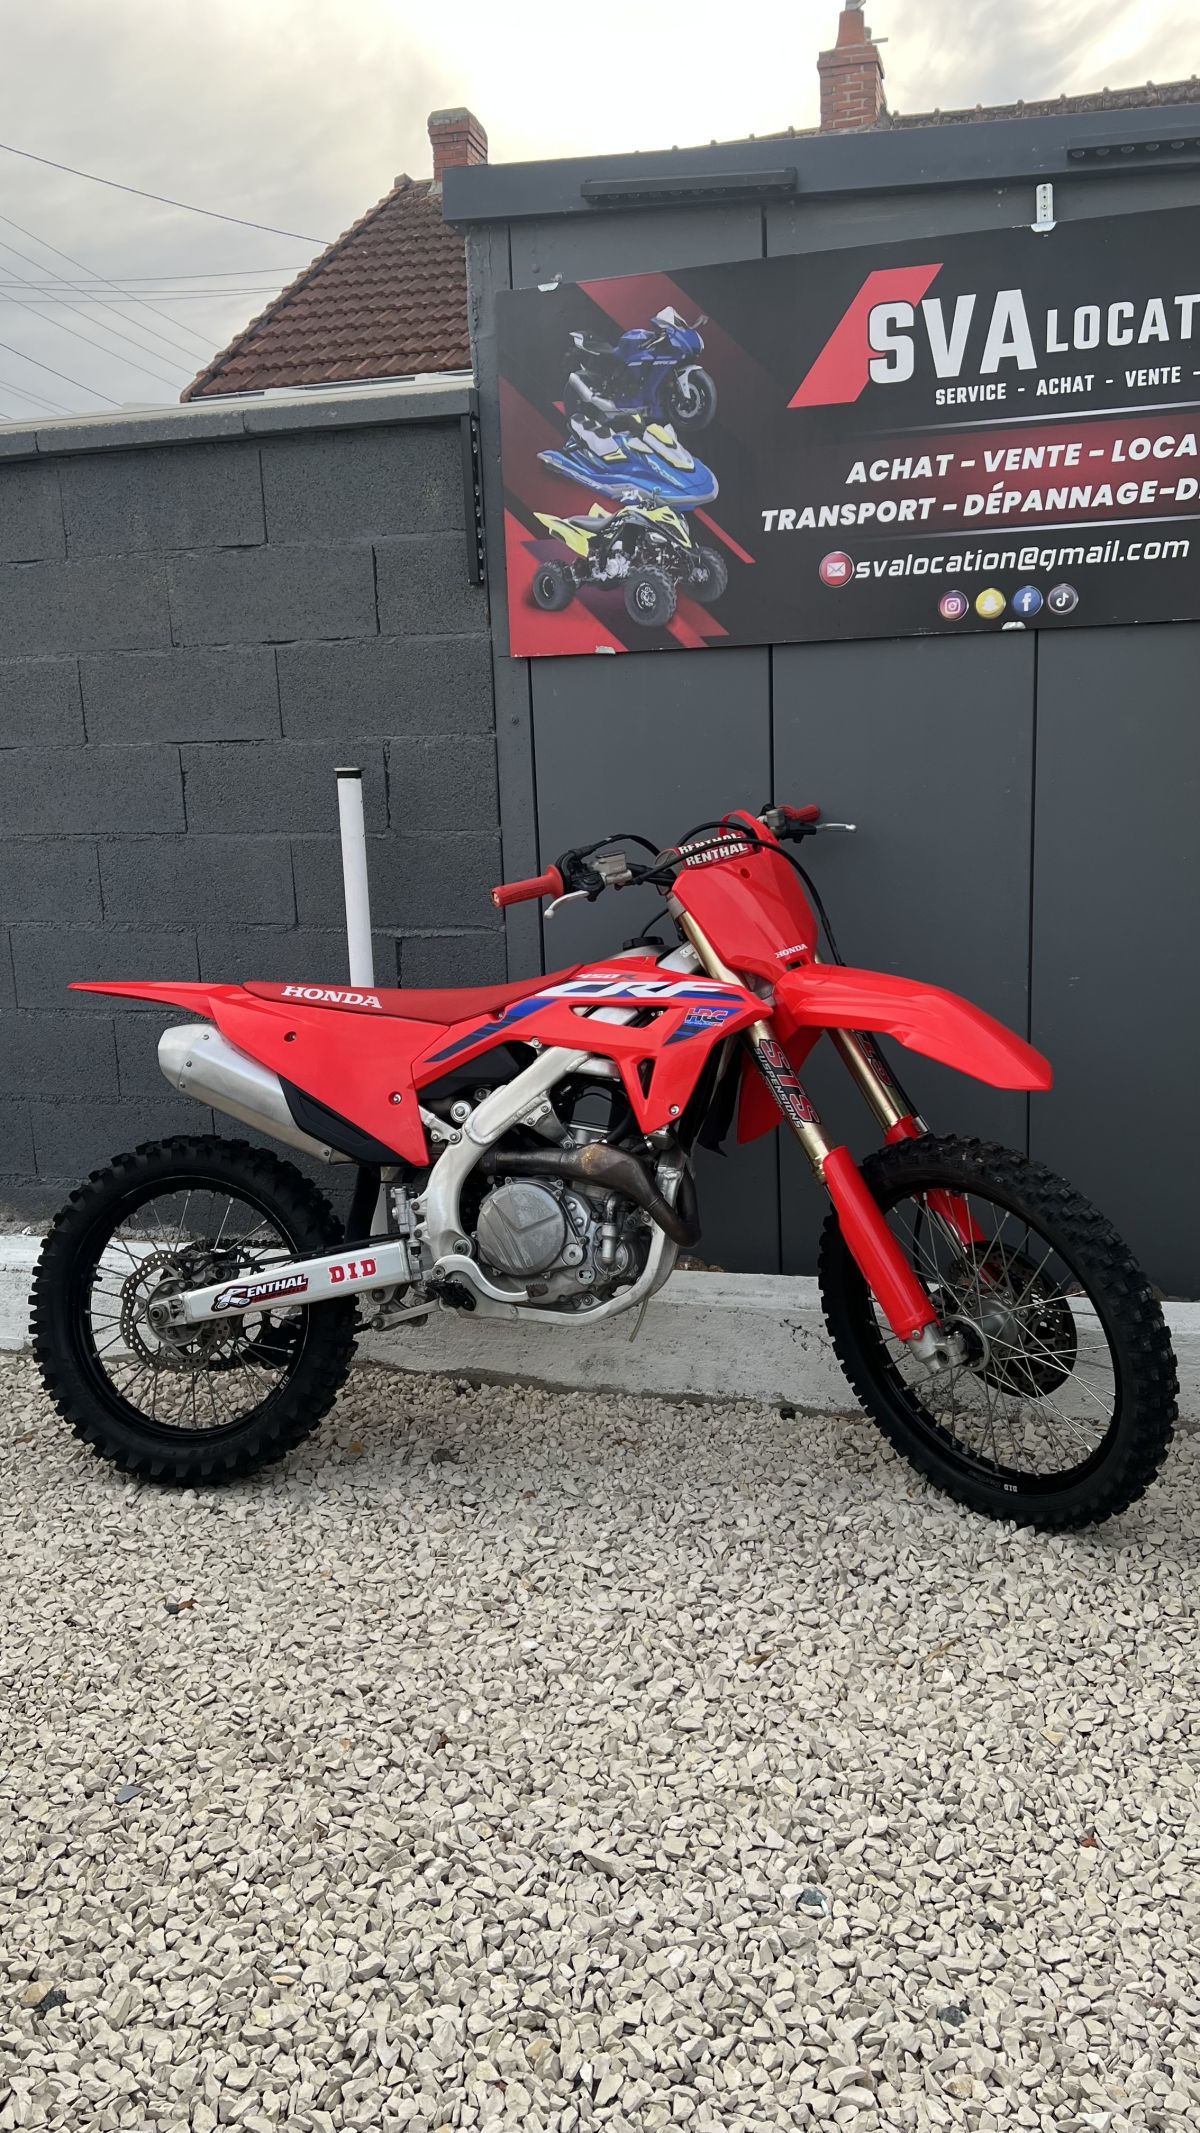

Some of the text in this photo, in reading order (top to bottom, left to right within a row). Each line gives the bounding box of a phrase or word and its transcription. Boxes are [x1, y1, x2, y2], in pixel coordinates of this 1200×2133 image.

[868, 289, 1037, 384] SVA
[935, 383, 1007, 406] SERVICE
[1036, 375, 1095, 396] ACHAT
[1125, 366, 1181, 388] VENTE
[846, 453, 954, 484] ACHAT
[983, 442, 1083, 473] VENTE
[761, 497, 937, 532] TRANSPORT
[855, 539, 1190, 578] svalocation@gmail.com
[685, 843, 748, 866] RENTHAL
[774, 943, 808, 959] HONDA
[281, 985, 382, 1008] HONDA
[535, 981, 736, 997] CRF
[685, 1007, 729, 1023] HRC
[754, 1047, 804, 1128] SUSPENSIONS
[759, 1040, 822, 1124] STS
